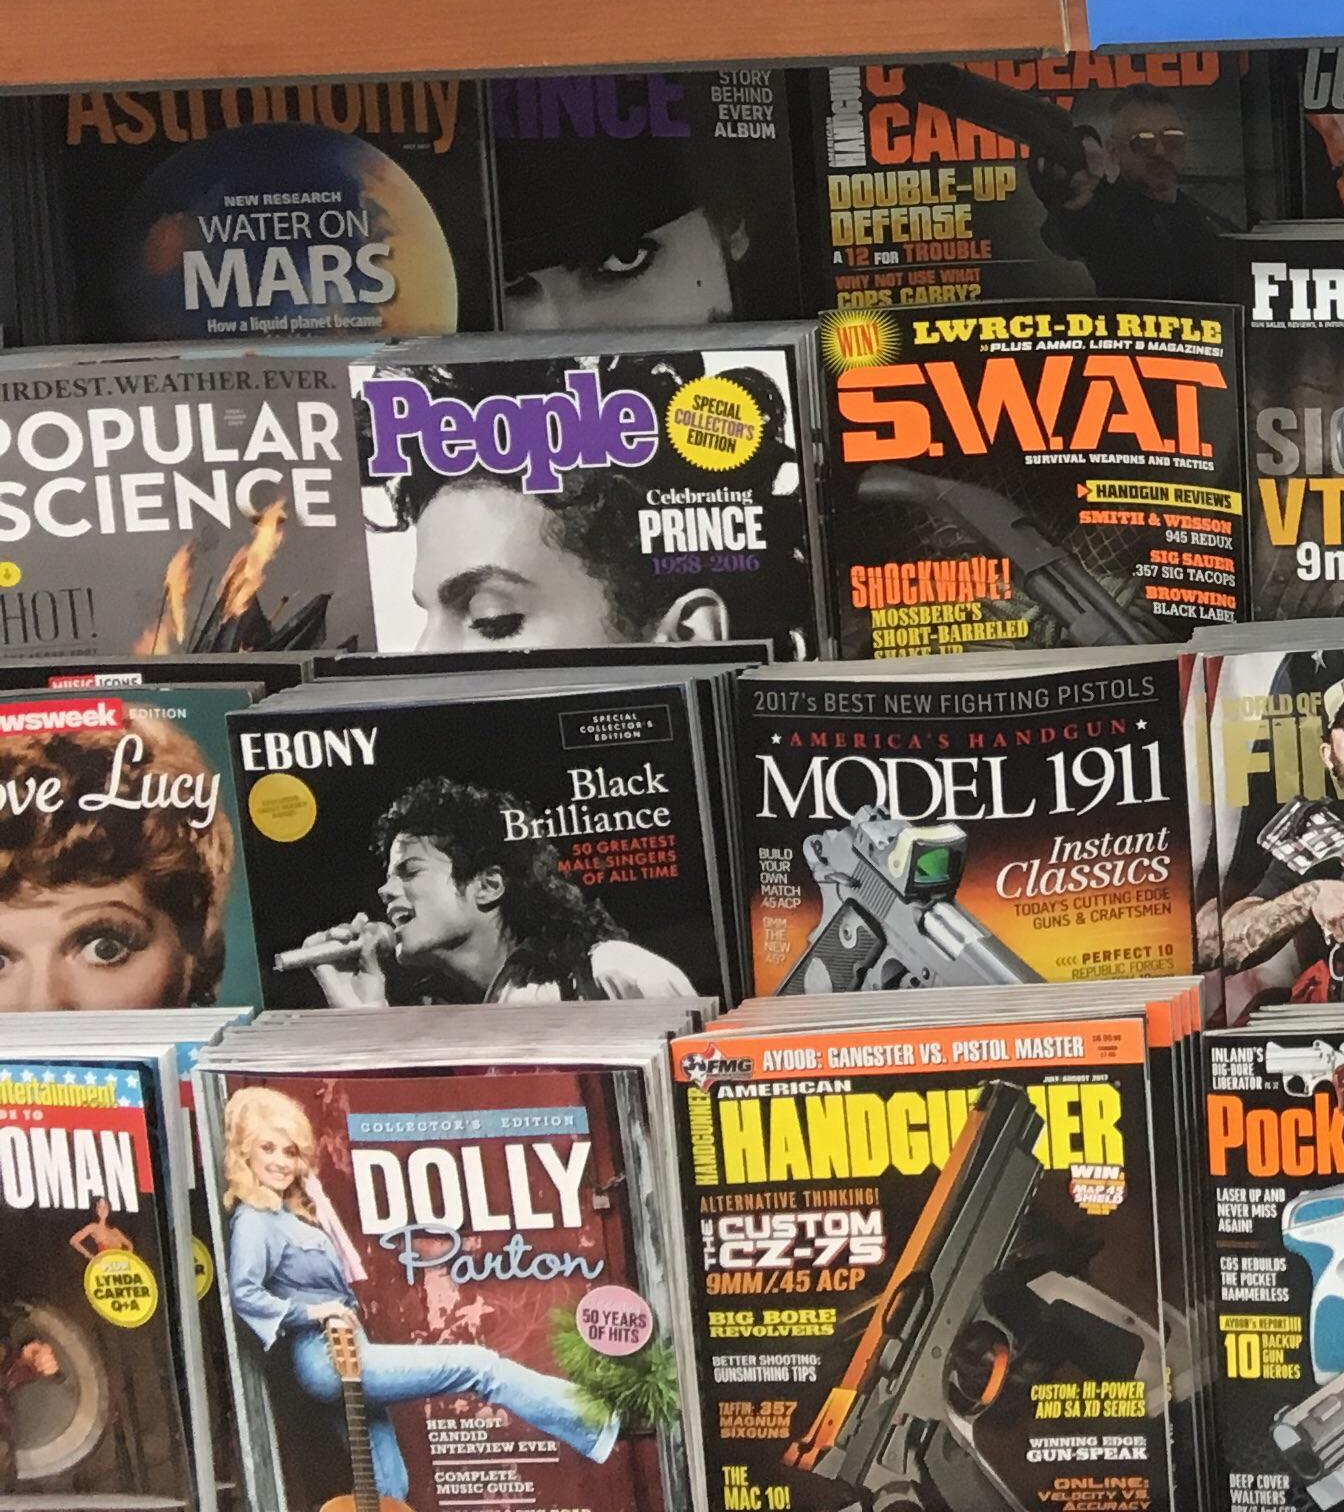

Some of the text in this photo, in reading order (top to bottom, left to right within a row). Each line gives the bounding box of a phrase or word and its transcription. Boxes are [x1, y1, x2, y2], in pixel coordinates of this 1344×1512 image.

[224, 190, 342, 208] NEW RESEARCH
[199, 210, 369, 244] WATER ON
[184, 244, 395, 310] MARS
[1116, 317, 1222, 344] RIFLE
[362, 370, 659, 495] People
[646, 488, 752, 506] Celebrating
[640, 506, 766, 553] PRINCE
[240, 728, 378, 771] EBONY
[567, 765, 669, 802] Black
[756, 743, 1170, 822] MODEL 1911
[502, 802, 672, 842] Brilliance
[1049, 829, 1169, 862] Instant
[995, 854, 1171, 900] Classics
[763, 1037, 1084, 1071] AYOOB: GANGSTER VS. PISTOL MASTER
[350, 1142, 591, 1234] DOLLY
[93, 1286, 150, 1300] CARTER
[96, 1274, 143, 1289] LYNDA
[710, 1322, 835, 1337] REVOLVERS
